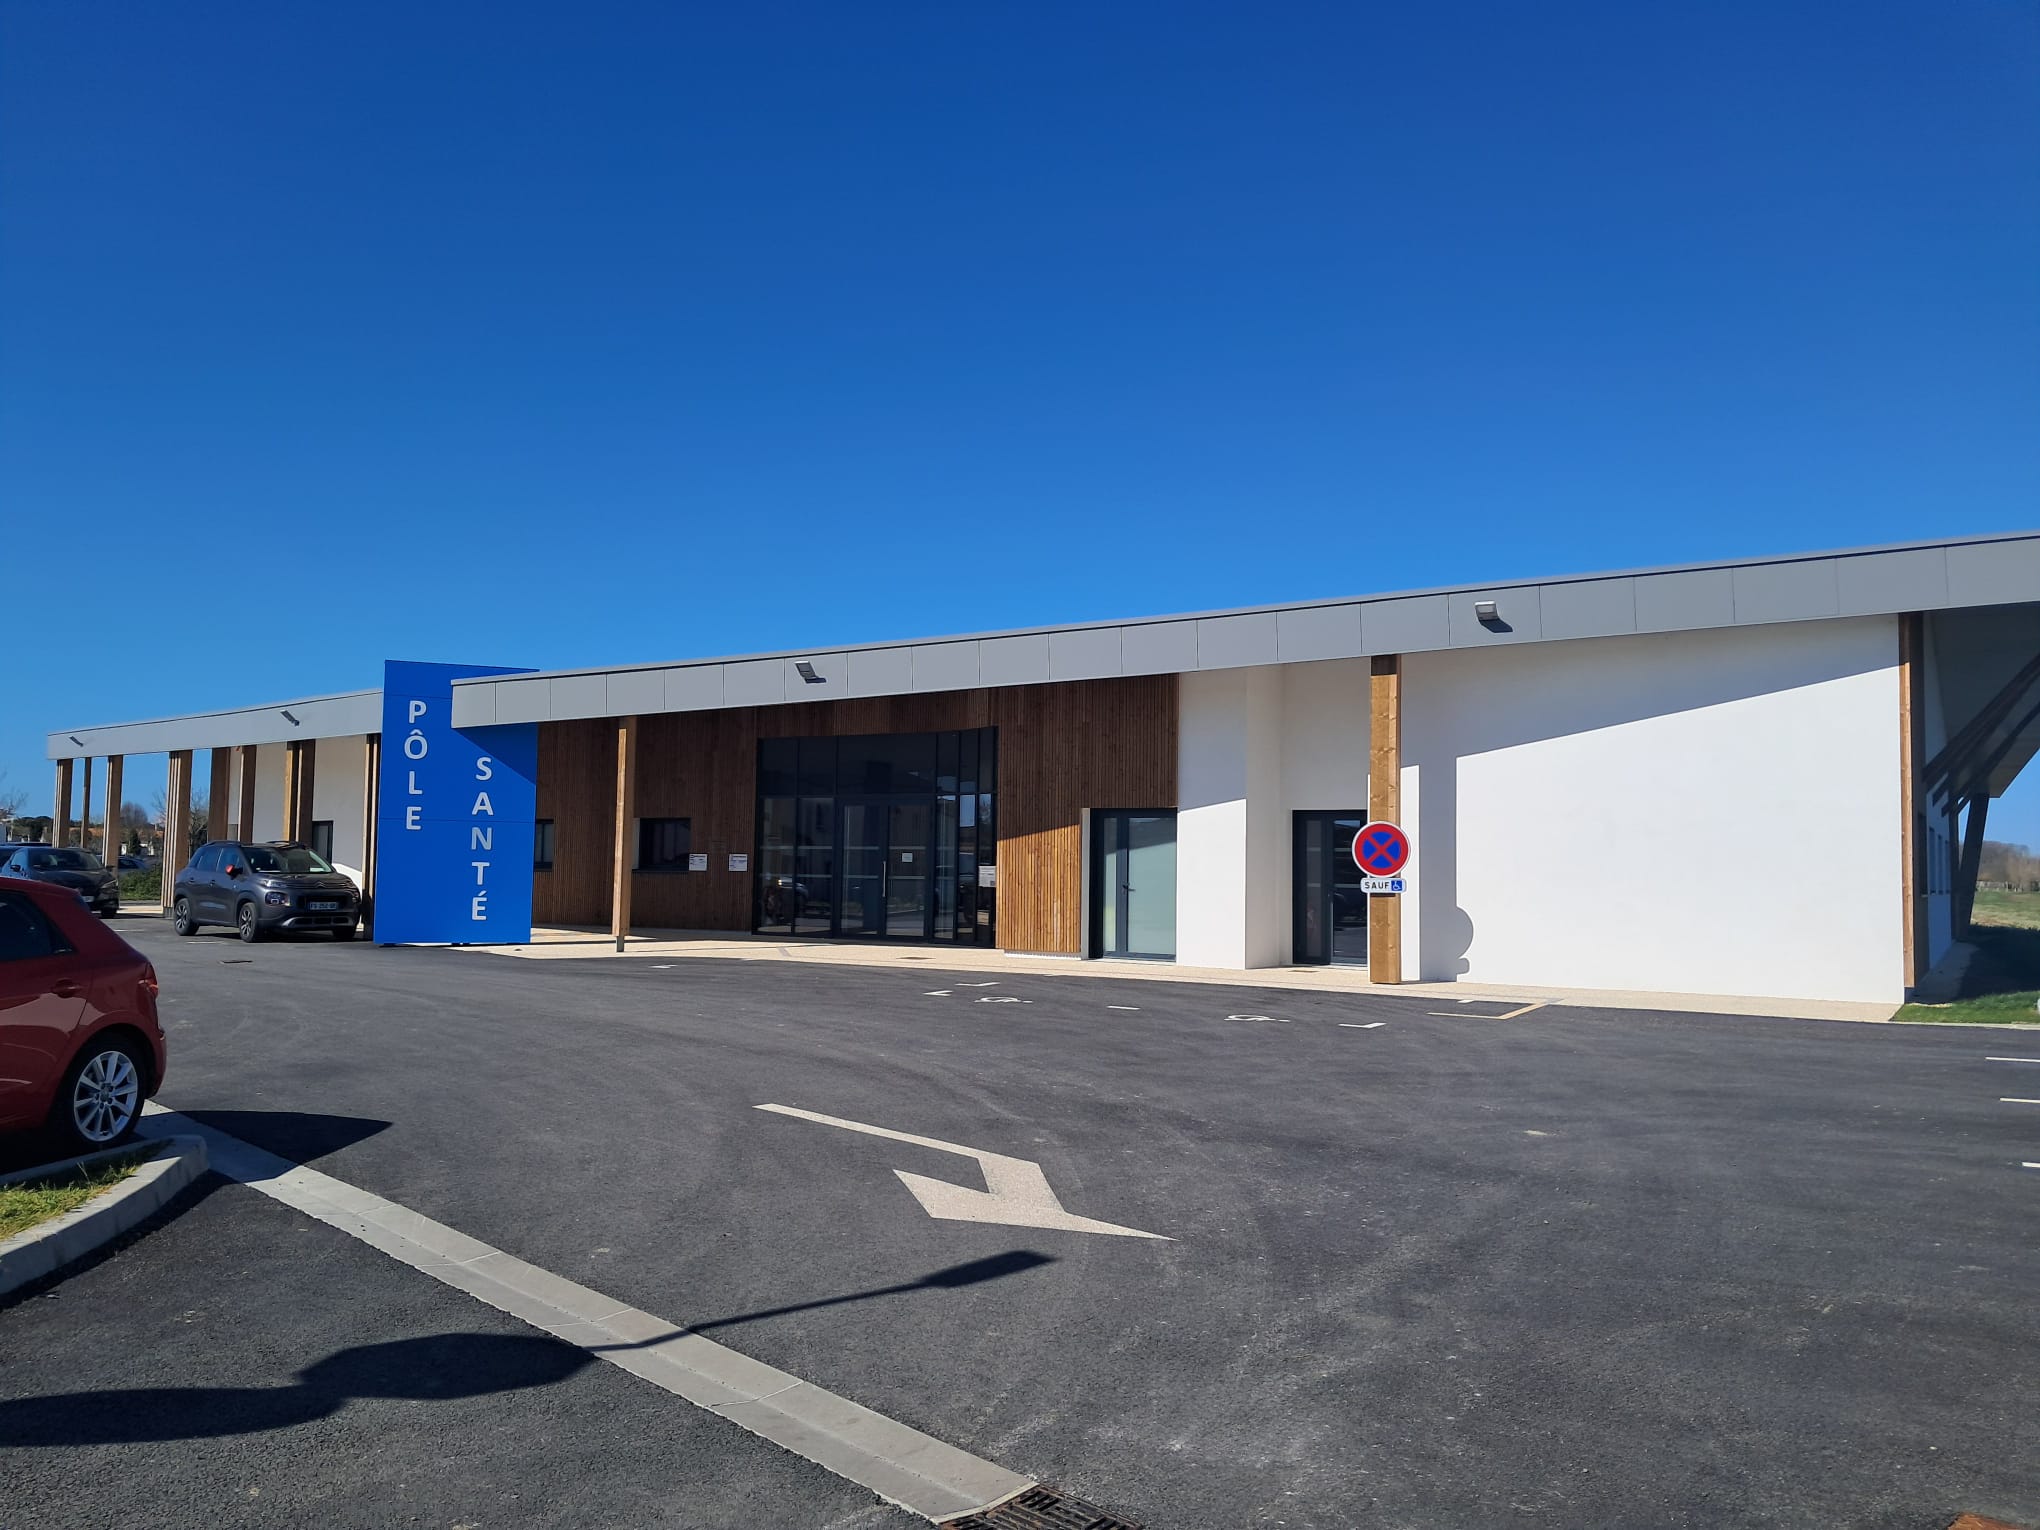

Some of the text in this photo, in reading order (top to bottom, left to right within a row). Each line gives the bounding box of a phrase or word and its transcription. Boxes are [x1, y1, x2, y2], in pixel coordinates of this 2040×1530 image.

[404, 700, 428, 830] PÔLE
[471, 757, 494, 920] SANTÉ
[1364, 881, 1390, 889] SAUF
